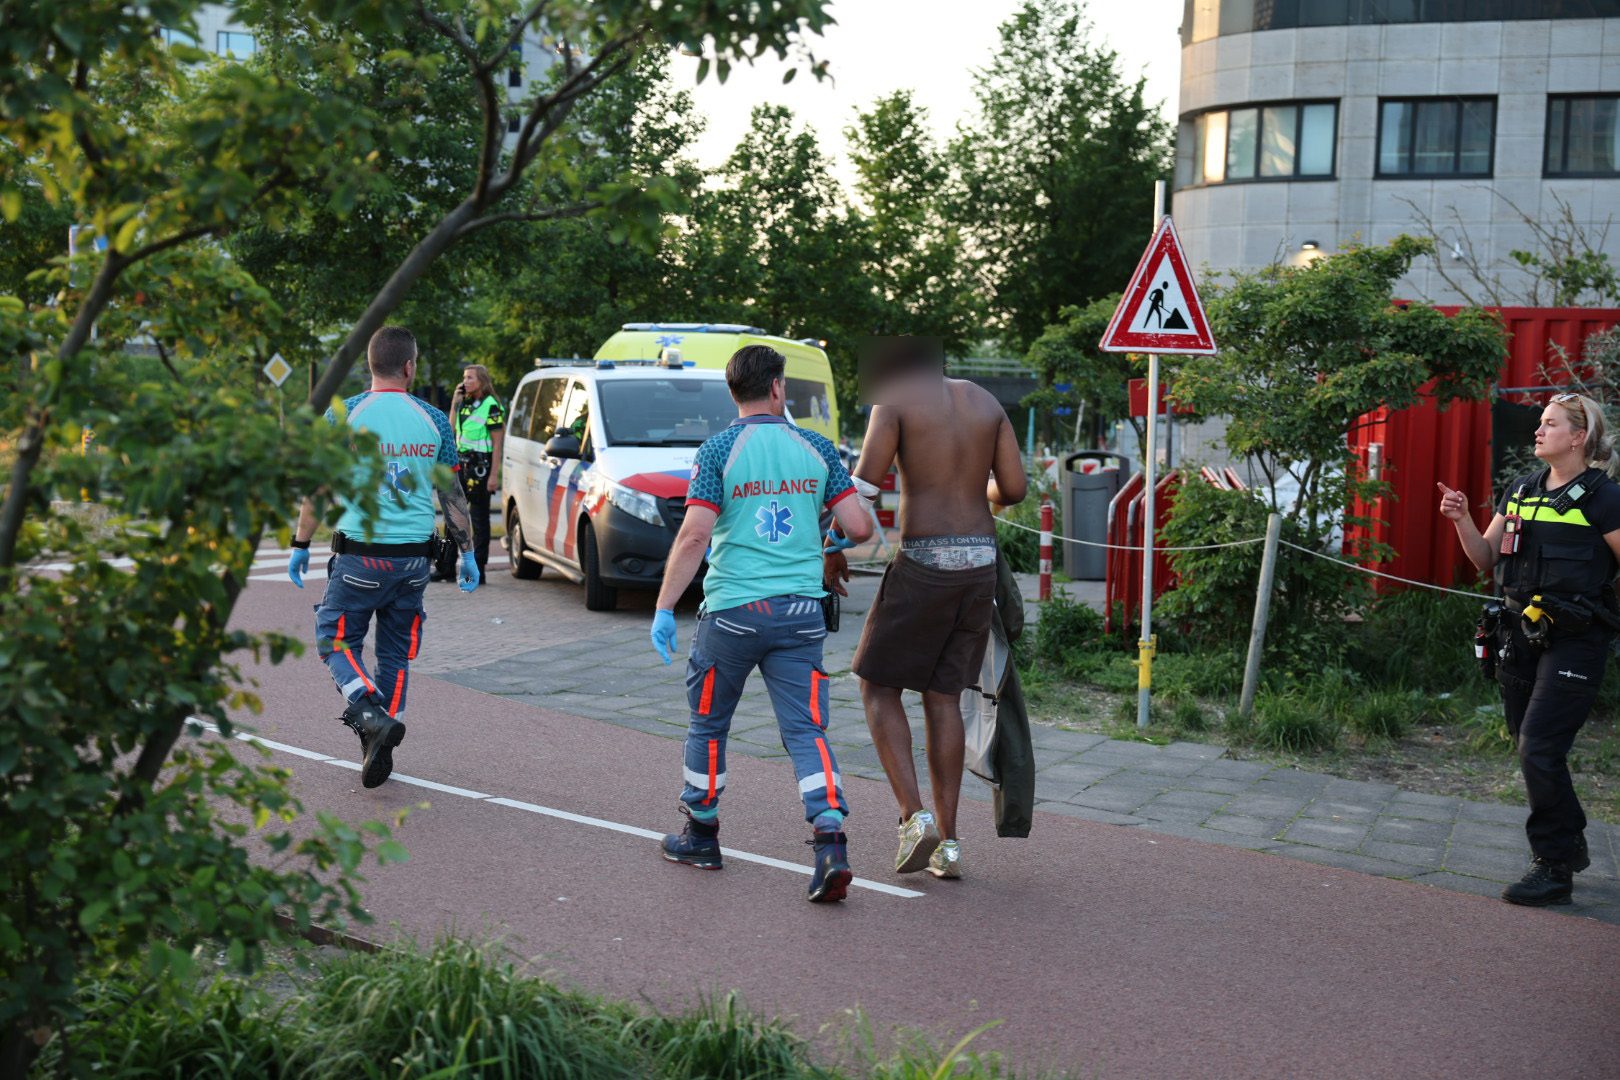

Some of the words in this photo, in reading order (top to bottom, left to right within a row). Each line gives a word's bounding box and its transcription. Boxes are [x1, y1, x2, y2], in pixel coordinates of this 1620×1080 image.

[375, 442, 436, 458] ULANCE
[732, 478, 818, 499] AMBULANCE
[928, 538, 949, 547] ASS
